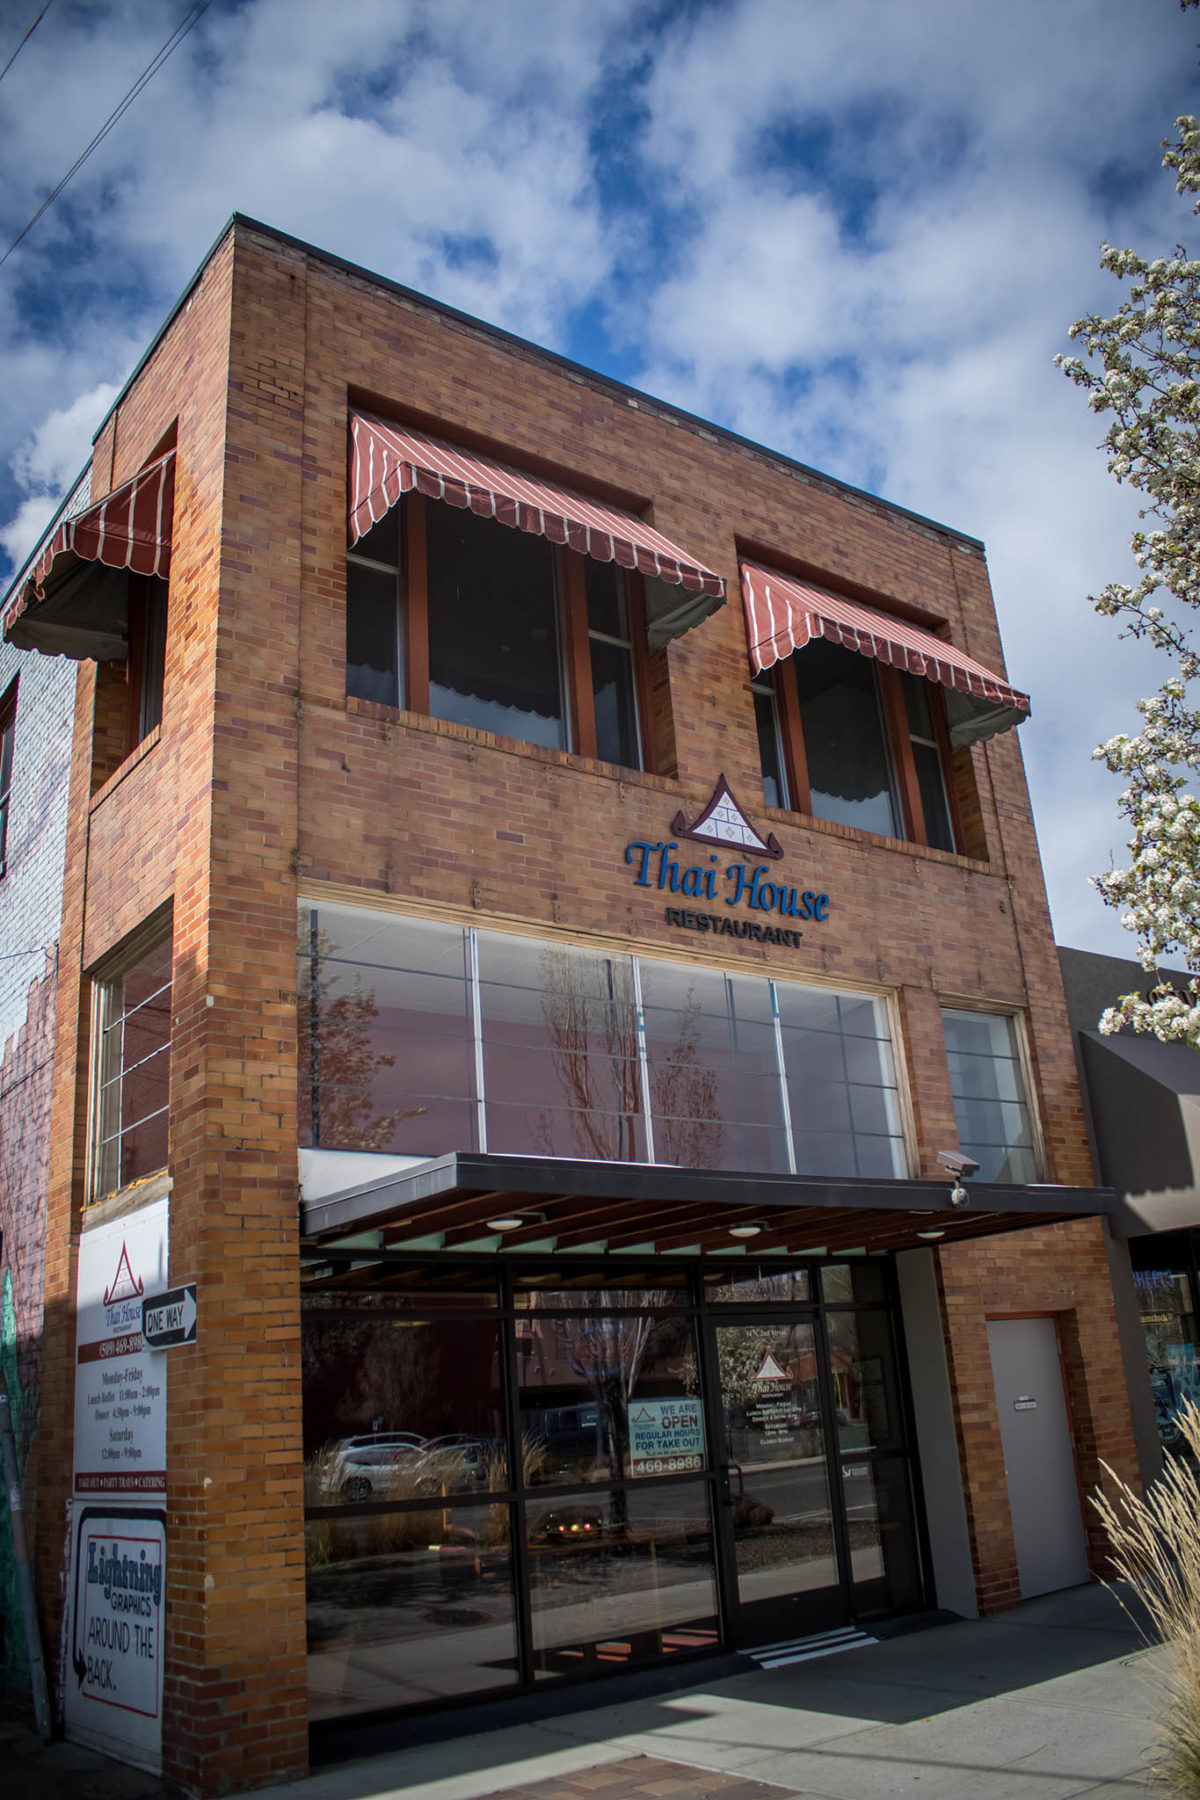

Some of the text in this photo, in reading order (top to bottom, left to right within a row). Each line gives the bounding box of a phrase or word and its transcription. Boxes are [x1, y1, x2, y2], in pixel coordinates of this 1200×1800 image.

[626, 841, 830, 921] Thai House
[665, 907, 803, 948] RESTAURANT
[106, 1302, 142, 1327] Thai House
[148, 1304, 184, 1333] ONE WAY
[116, 1334, 143, 1354] 469-898
[660, 1404, 697, 1415] WE ARE
[662, 1415, 698, 1429] OPEN
[109, 1427, 134, 1445] Saturday
[635, 1428, 701, 1440] REGULAR HOURS
[636, 1437, 700, 1451] FOR TAKE OUT
[637, 1456, 702, 1473] 469-8986
[88, 1542, 162, 1606] Lightning
[111, 1592, 151, 1617] GRAPHICS
[88, 1616, 154, 1660] AROUND THE
[87, 1655, 117, 1691] BACK.
